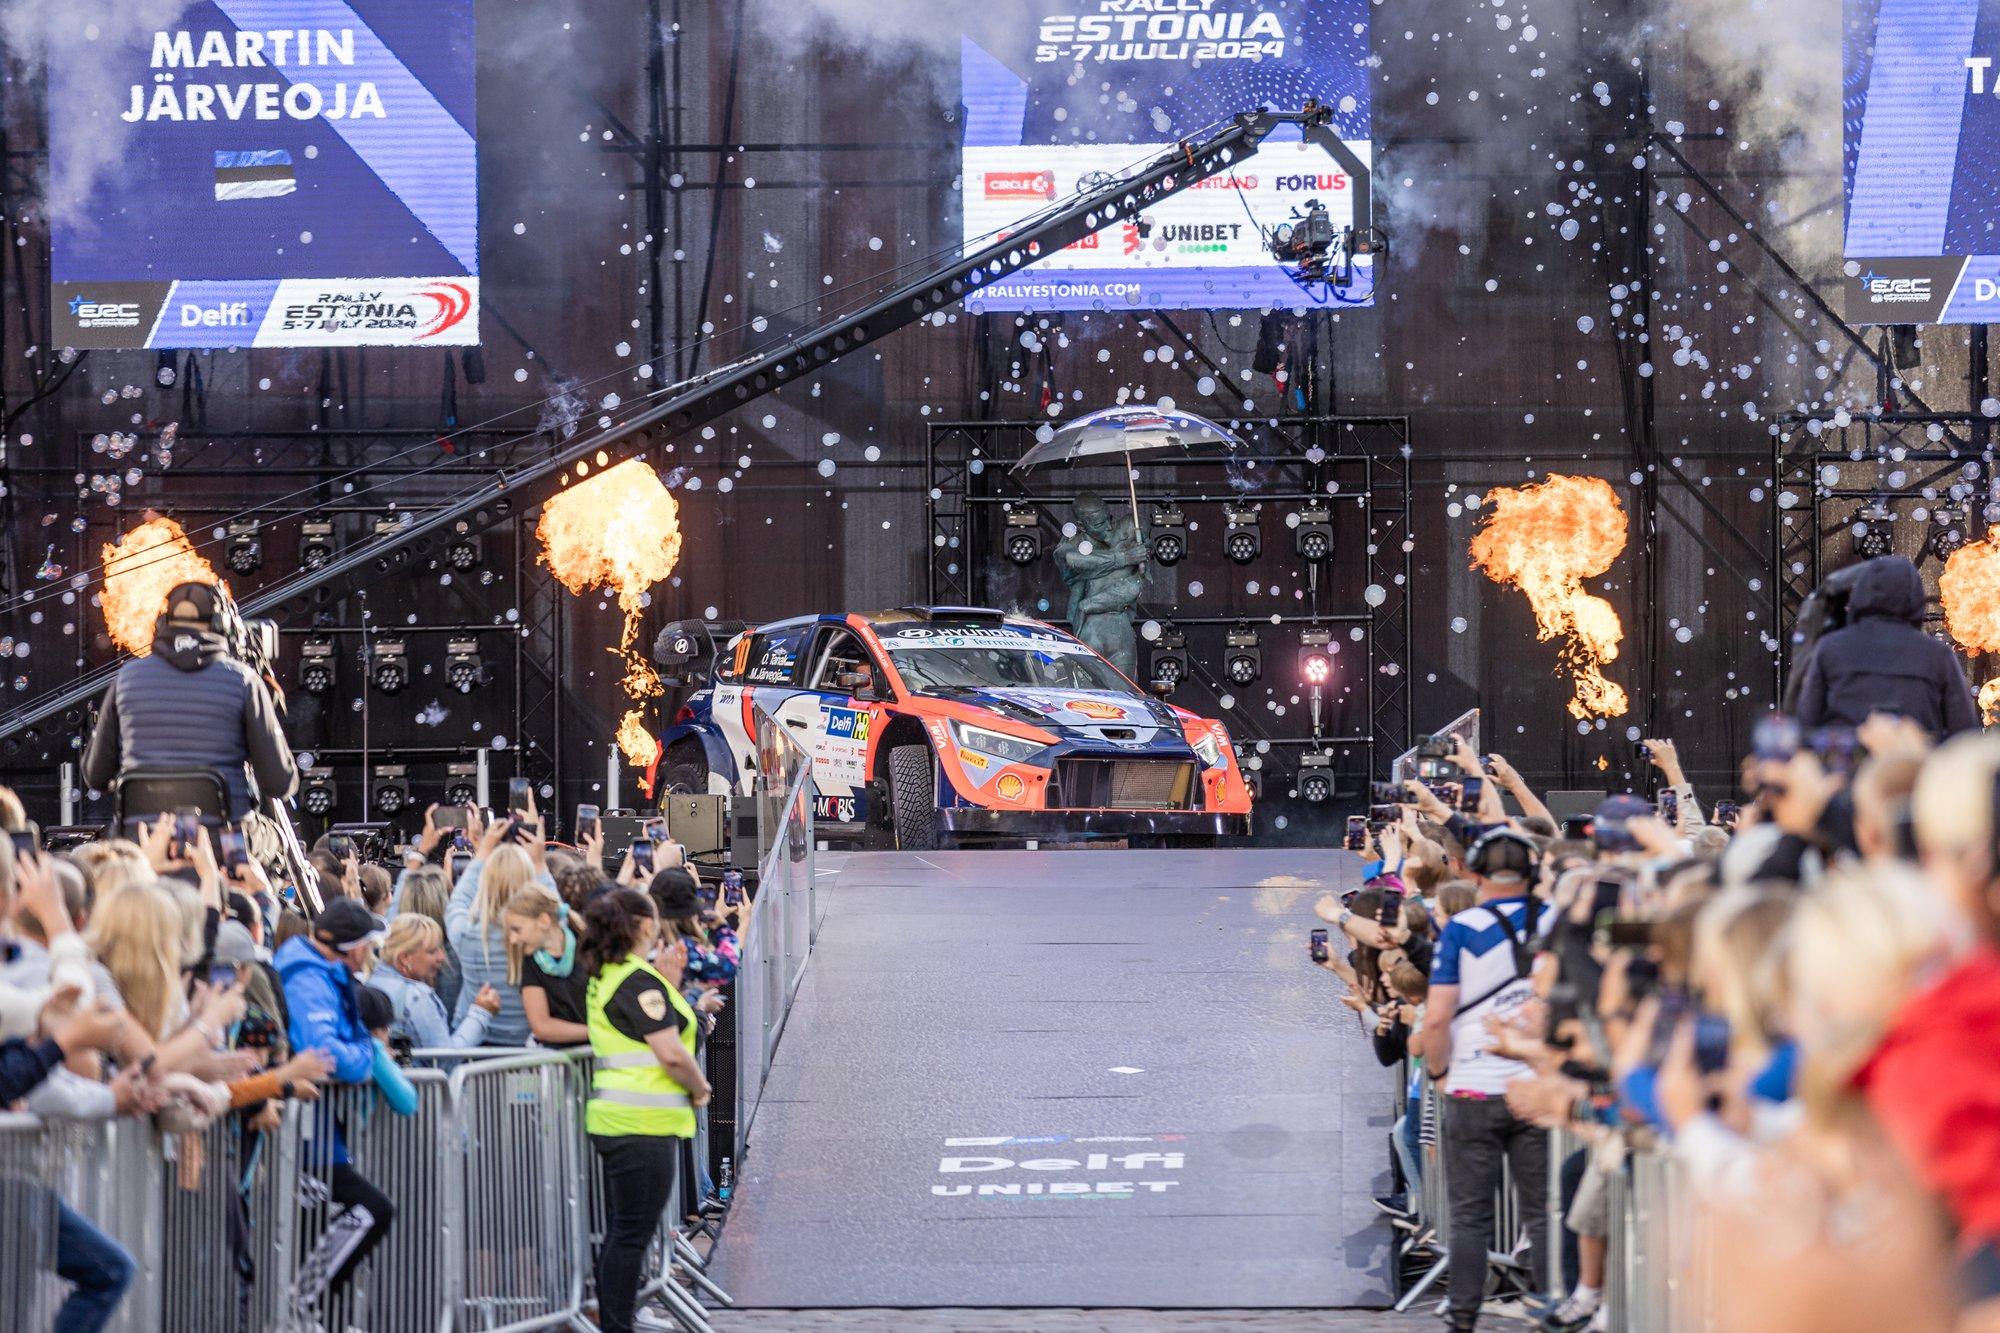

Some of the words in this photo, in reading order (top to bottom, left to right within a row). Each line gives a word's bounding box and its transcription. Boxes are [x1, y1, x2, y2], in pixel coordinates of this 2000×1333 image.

[1039, 12, 1286, 42] ESTONIA
[150, 29, 355, 68] MARTIN
[1035, 44, 1093, 62] 5-7
[1094, 42, 1190, 61] JUULI
[1194, 41, 1285, 59] 2024
[120, 73, 387, 122] JÄRVEOJA
[1275, 174, 1346, 192] FORUS
[1162, 223, 1242, 242] UNIBET
[987, 283, 1142, 299] RALLYESTONIA.COM
[181, 302, 248, 328] Delfi
[286, 303, 417, 319] ESTONIA
[972, 638, 1030, 647] Terminal
[830, 715, 852, 732] Delfi
[938, 1152, 1186, 1173] Delfi
[931, 1181, 1180, 1196] UNIBET
